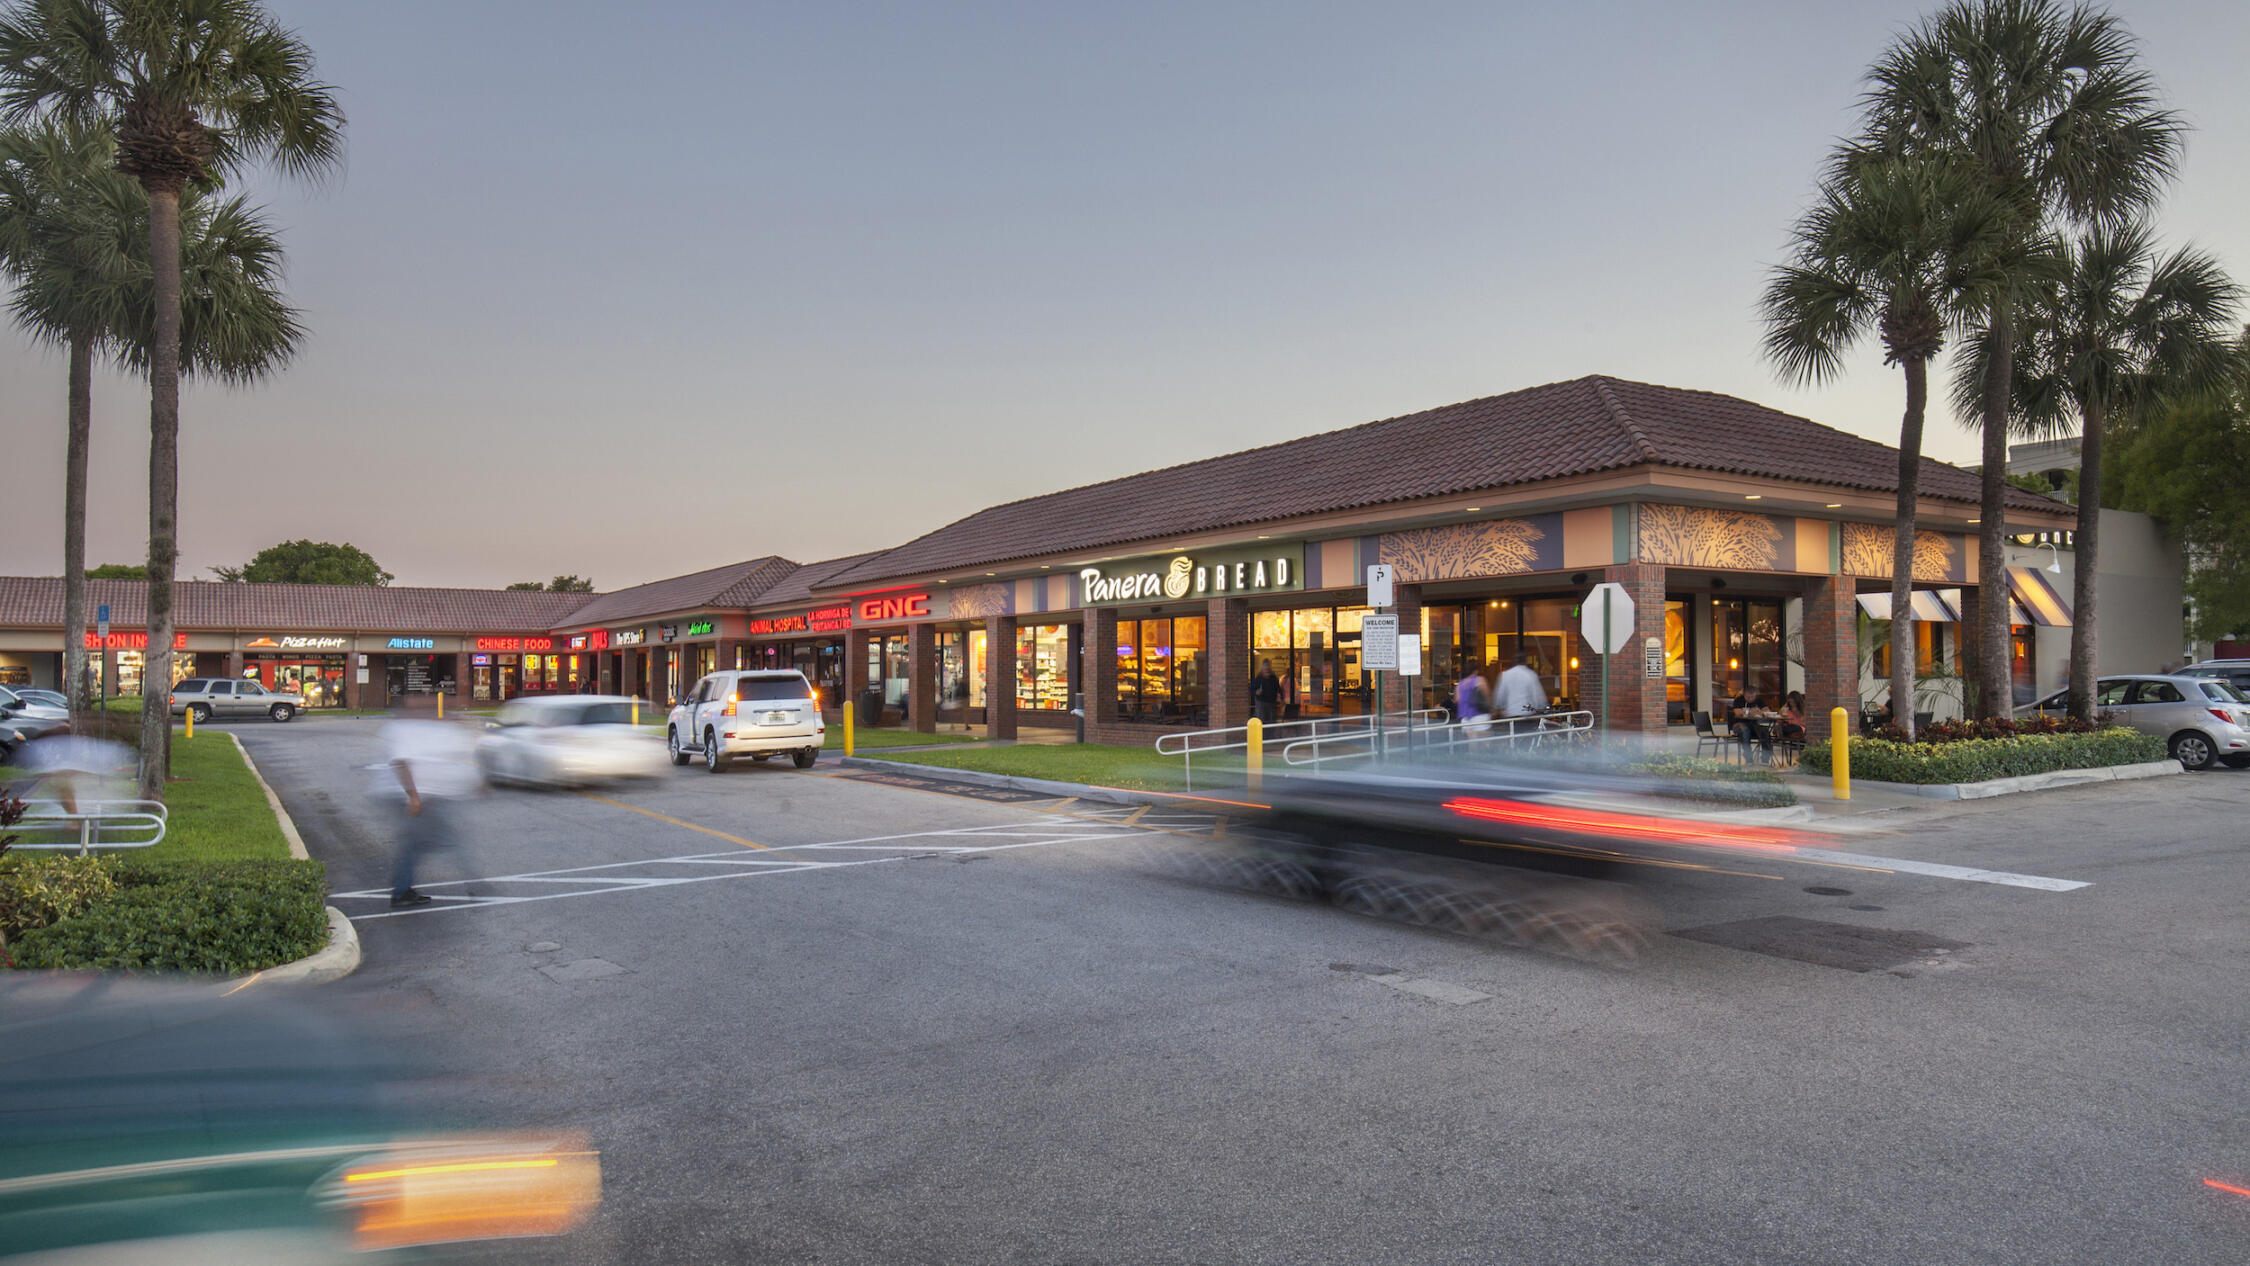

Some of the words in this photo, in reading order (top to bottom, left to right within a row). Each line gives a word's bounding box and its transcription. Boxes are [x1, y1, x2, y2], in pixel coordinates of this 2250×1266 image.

[1080, 568, 1161, 602] Panera
[1197, 558, 1289, 592] BREAD
[860, 594, 928, 620] GNC
[750, 620, 773, 634] ANIMAL
[774, 616, 806, 632] HOSPITAL
[386, 638, 433, 649] Allstate
[477, 638, 519, 650] CHINESE
[524, 638, 552, 650] FOOD
